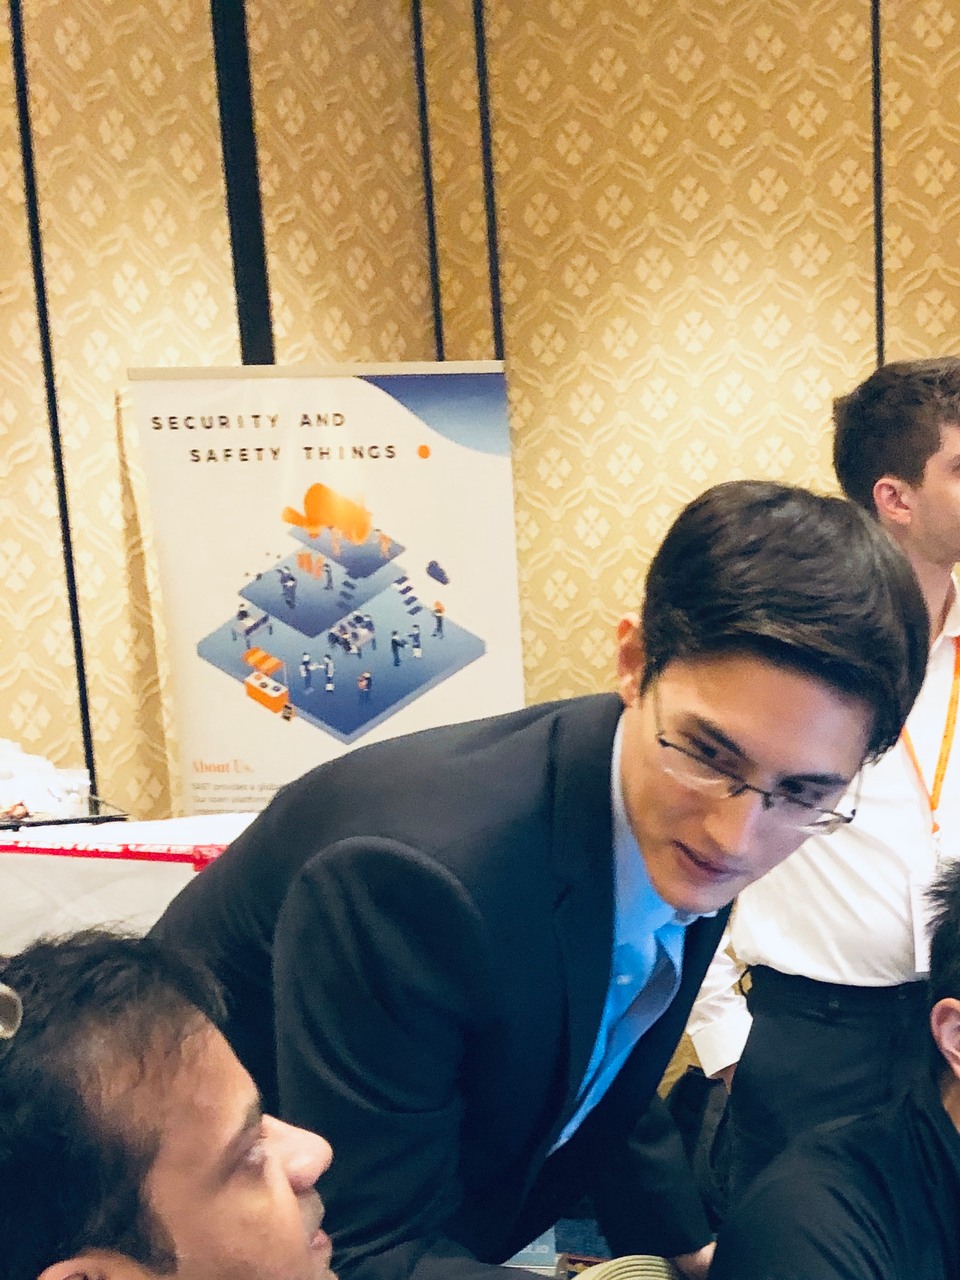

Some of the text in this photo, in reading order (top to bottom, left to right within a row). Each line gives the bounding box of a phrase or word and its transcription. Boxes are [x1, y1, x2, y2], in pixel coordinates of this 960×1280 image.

[152, 412, 346, 430] SECURITY AND
[189, 445, 396, 463] SAFETY THINGS
